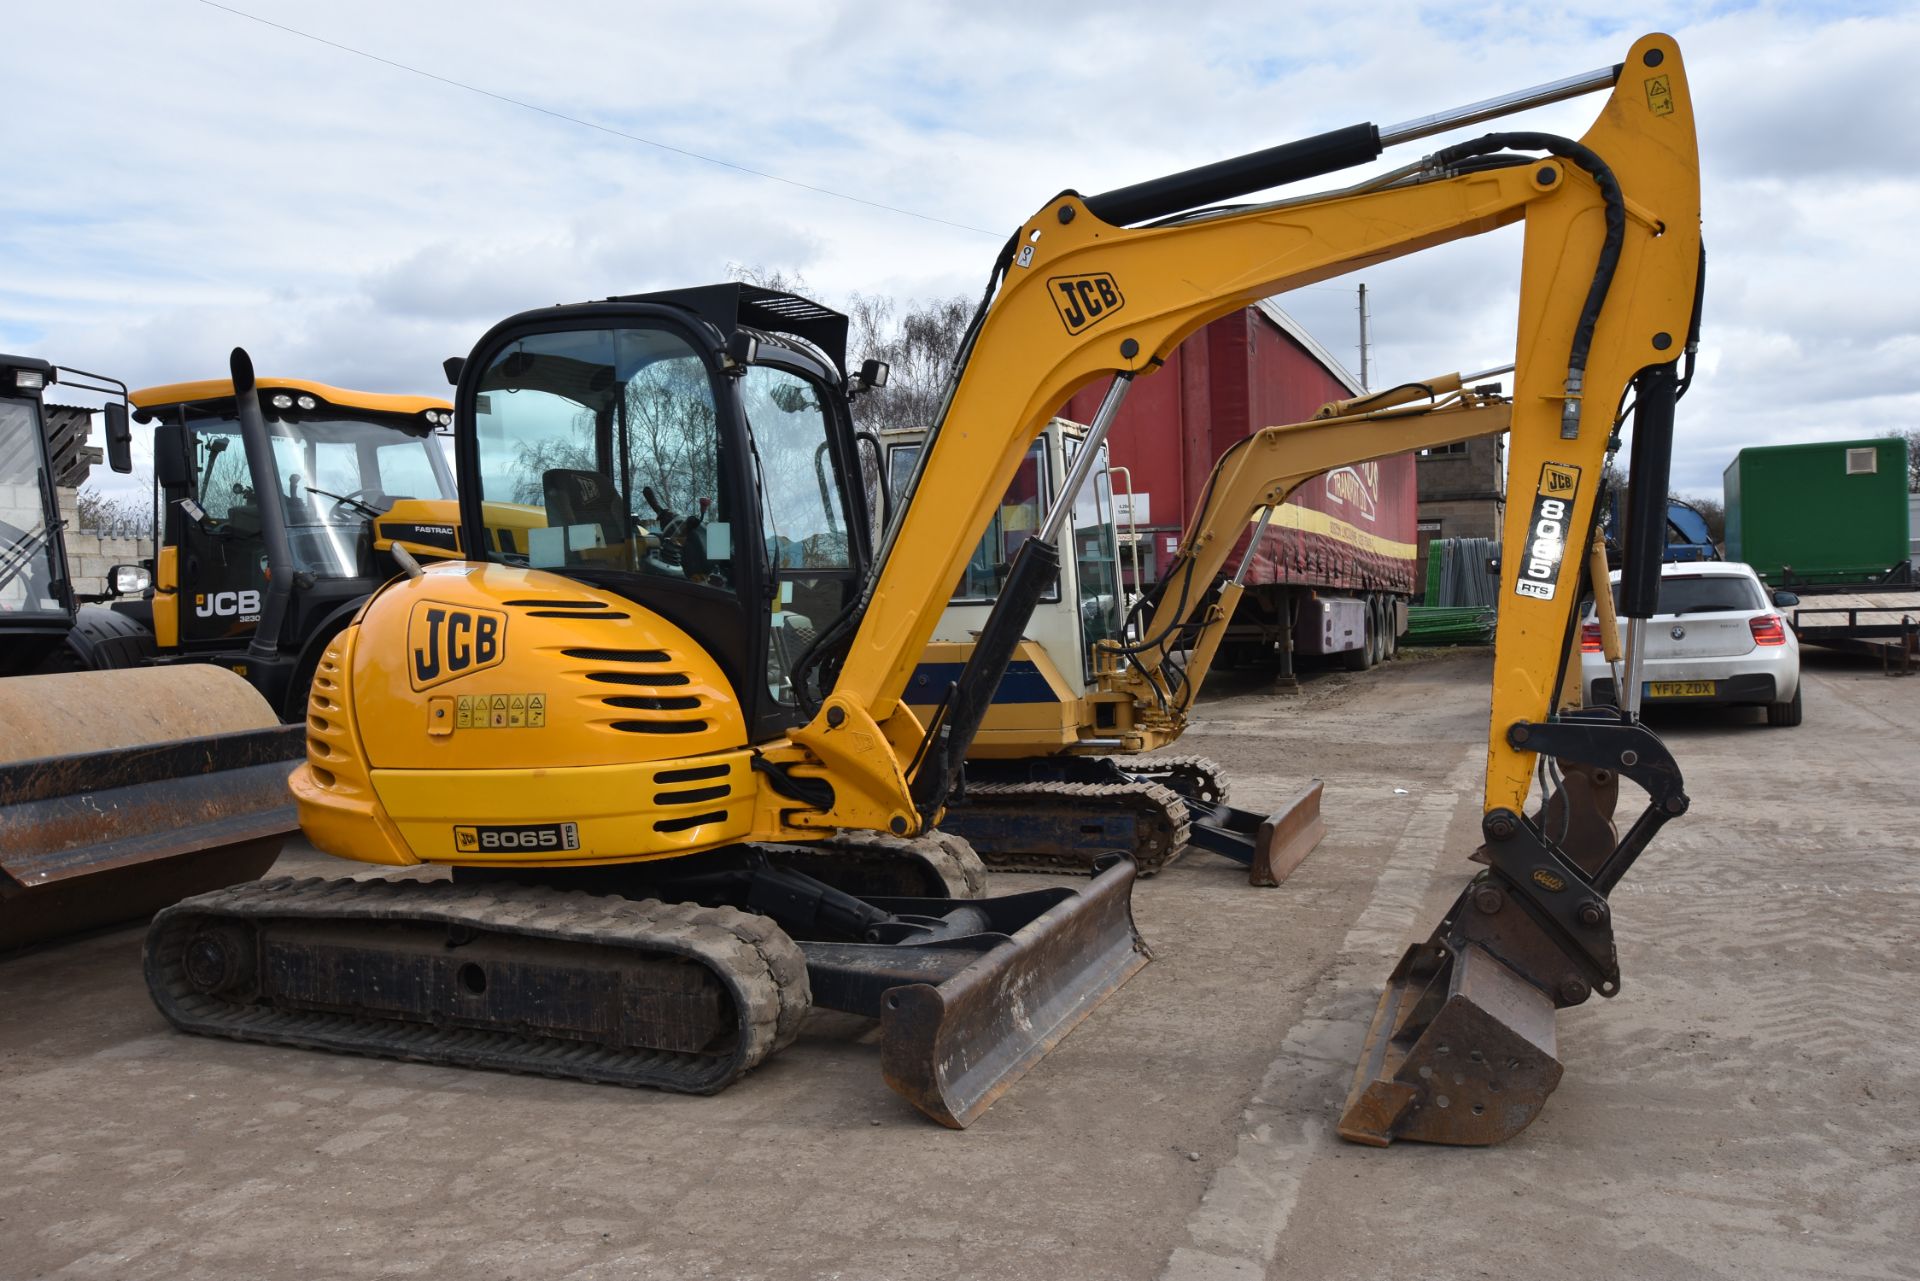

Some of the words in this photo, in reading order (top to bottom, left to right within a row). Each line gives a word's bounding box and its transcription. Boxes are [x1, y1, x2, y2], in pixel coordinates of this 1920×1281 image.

[1058, 278, 1118, 328] JCB
[1549, 472, 1573, 490] JCB
[415, 525, 454, 535] FASTRAC
[1527, 499, 1566, 579] 8065
[1521, 583, 1549, 595] RTS
[196, 590, 261, 618] JCB
[239, 614, 261, 623] 3230
[414, 608, 498, 681] JCB
[1655, 683, 1682, 696] YF12
[1686, 682, 1711, 695] ZDX
[460, 832, 476, 846] JCB
[481, 830, 558, 848] 8065
[565, 825, 575, 848] RTS
